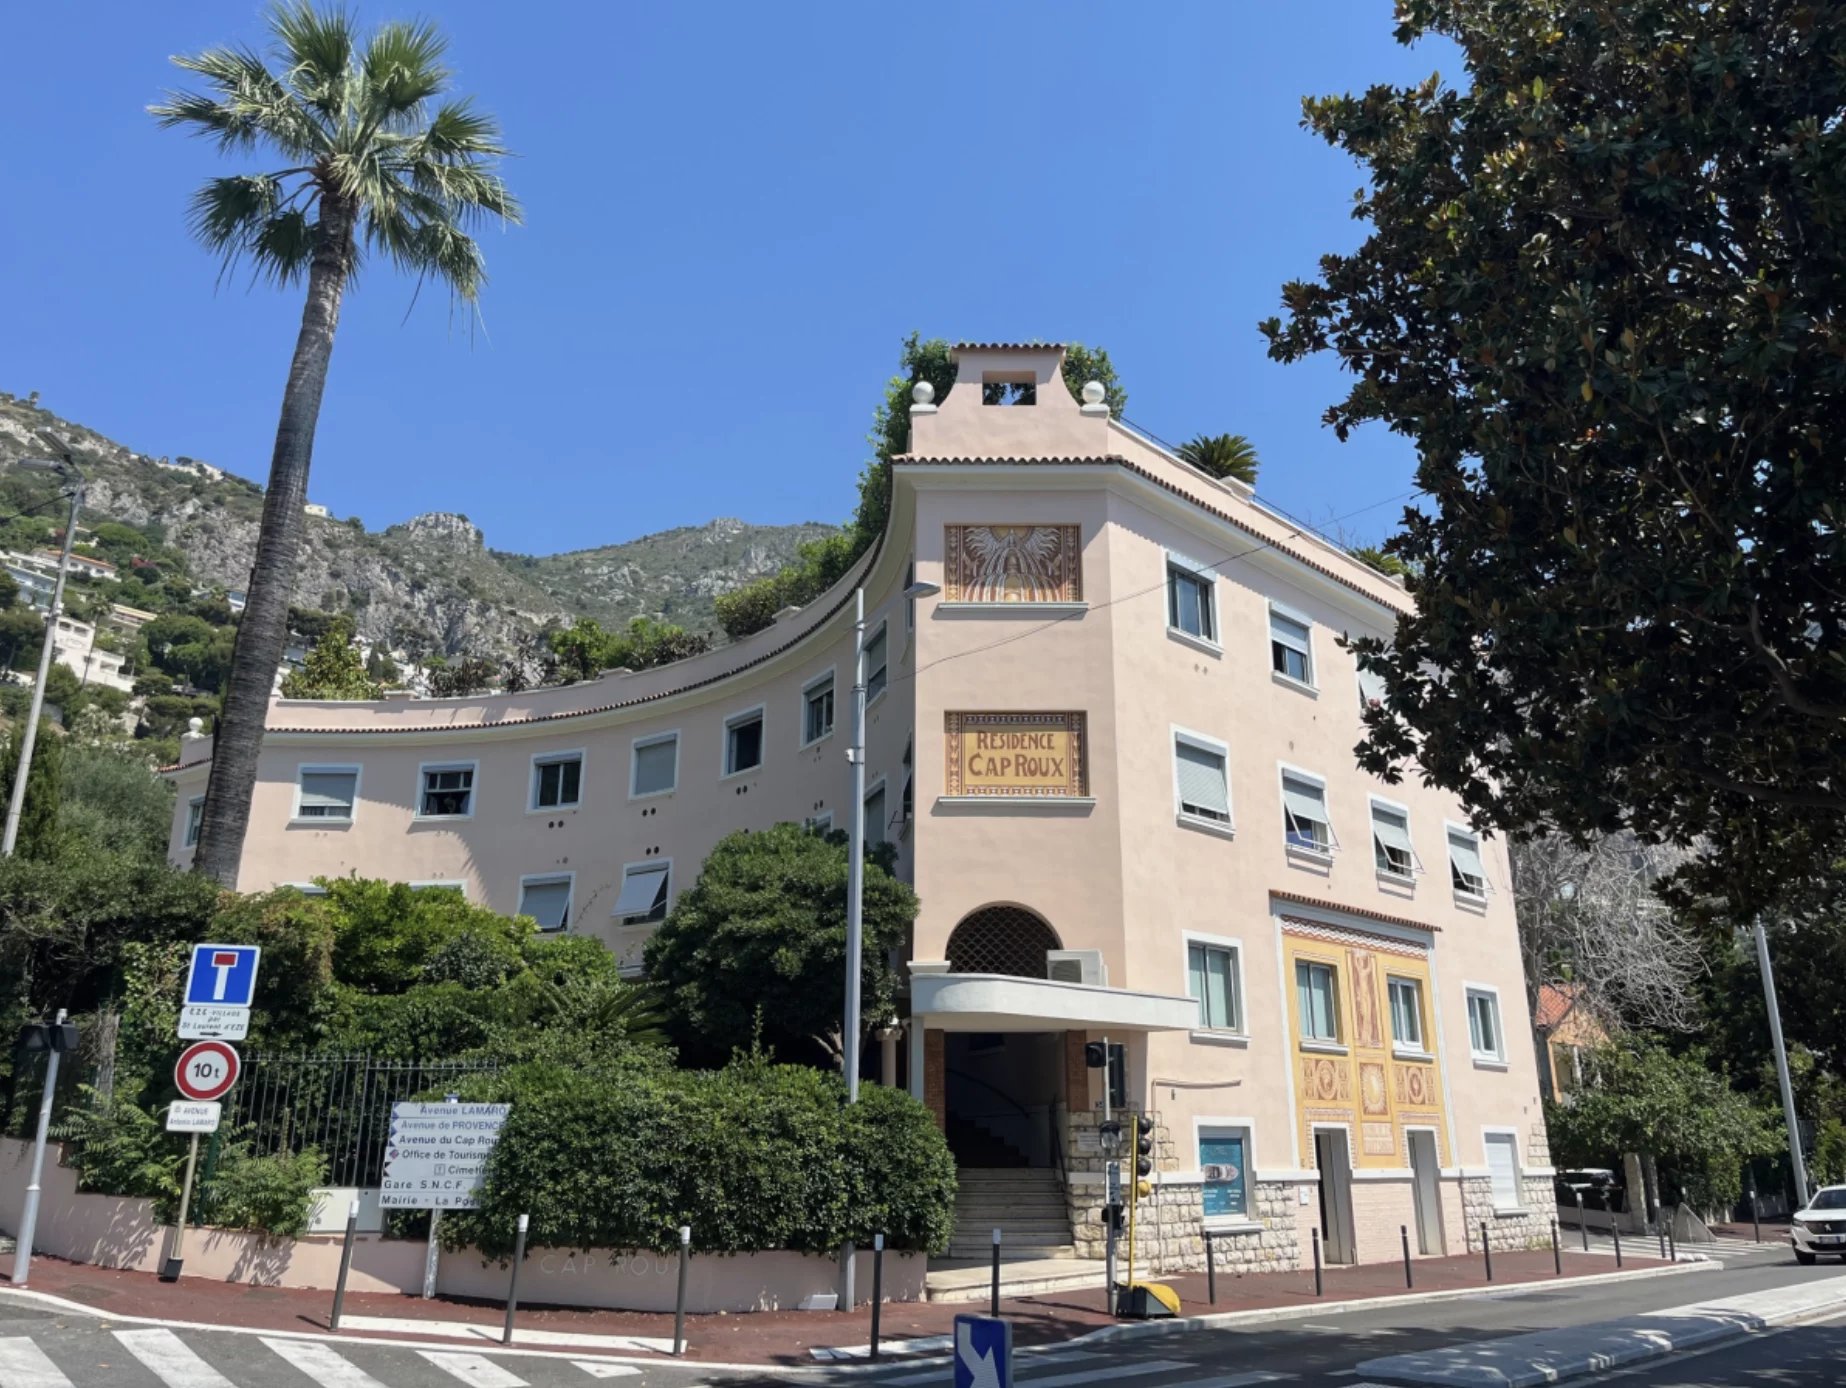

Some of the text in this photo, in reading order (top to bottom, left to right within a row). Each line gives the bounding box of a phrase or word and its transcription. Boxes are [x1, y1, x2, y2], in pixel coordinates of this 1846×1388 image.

[977, 730, 1055, 749] RESIDENCE
[968, 752, 1064, 777] CAP ROUX
[192, 1022, 222, 1030] Laurent
[194, 1063, 219, 1078] 10 t
[421, 1104, 458, 1115] Avenue
[401, 1120, 436, 1130] Avenue
[438, 1120, 450, 1129] de
[399, 1135, 502, 1147] Avenue du Cap Rou
[401, 1149, 431, 1160] Office
[433, 1149, 446, 1160] de
[384, 1180, 412, 1189] Gare
[381, 1195, 418, 1205] Mairie
[435, 1196, 449, 1206] La
[455, 1196, 485, 1206] Post
[540, 1254, 596, 1275] CAP
